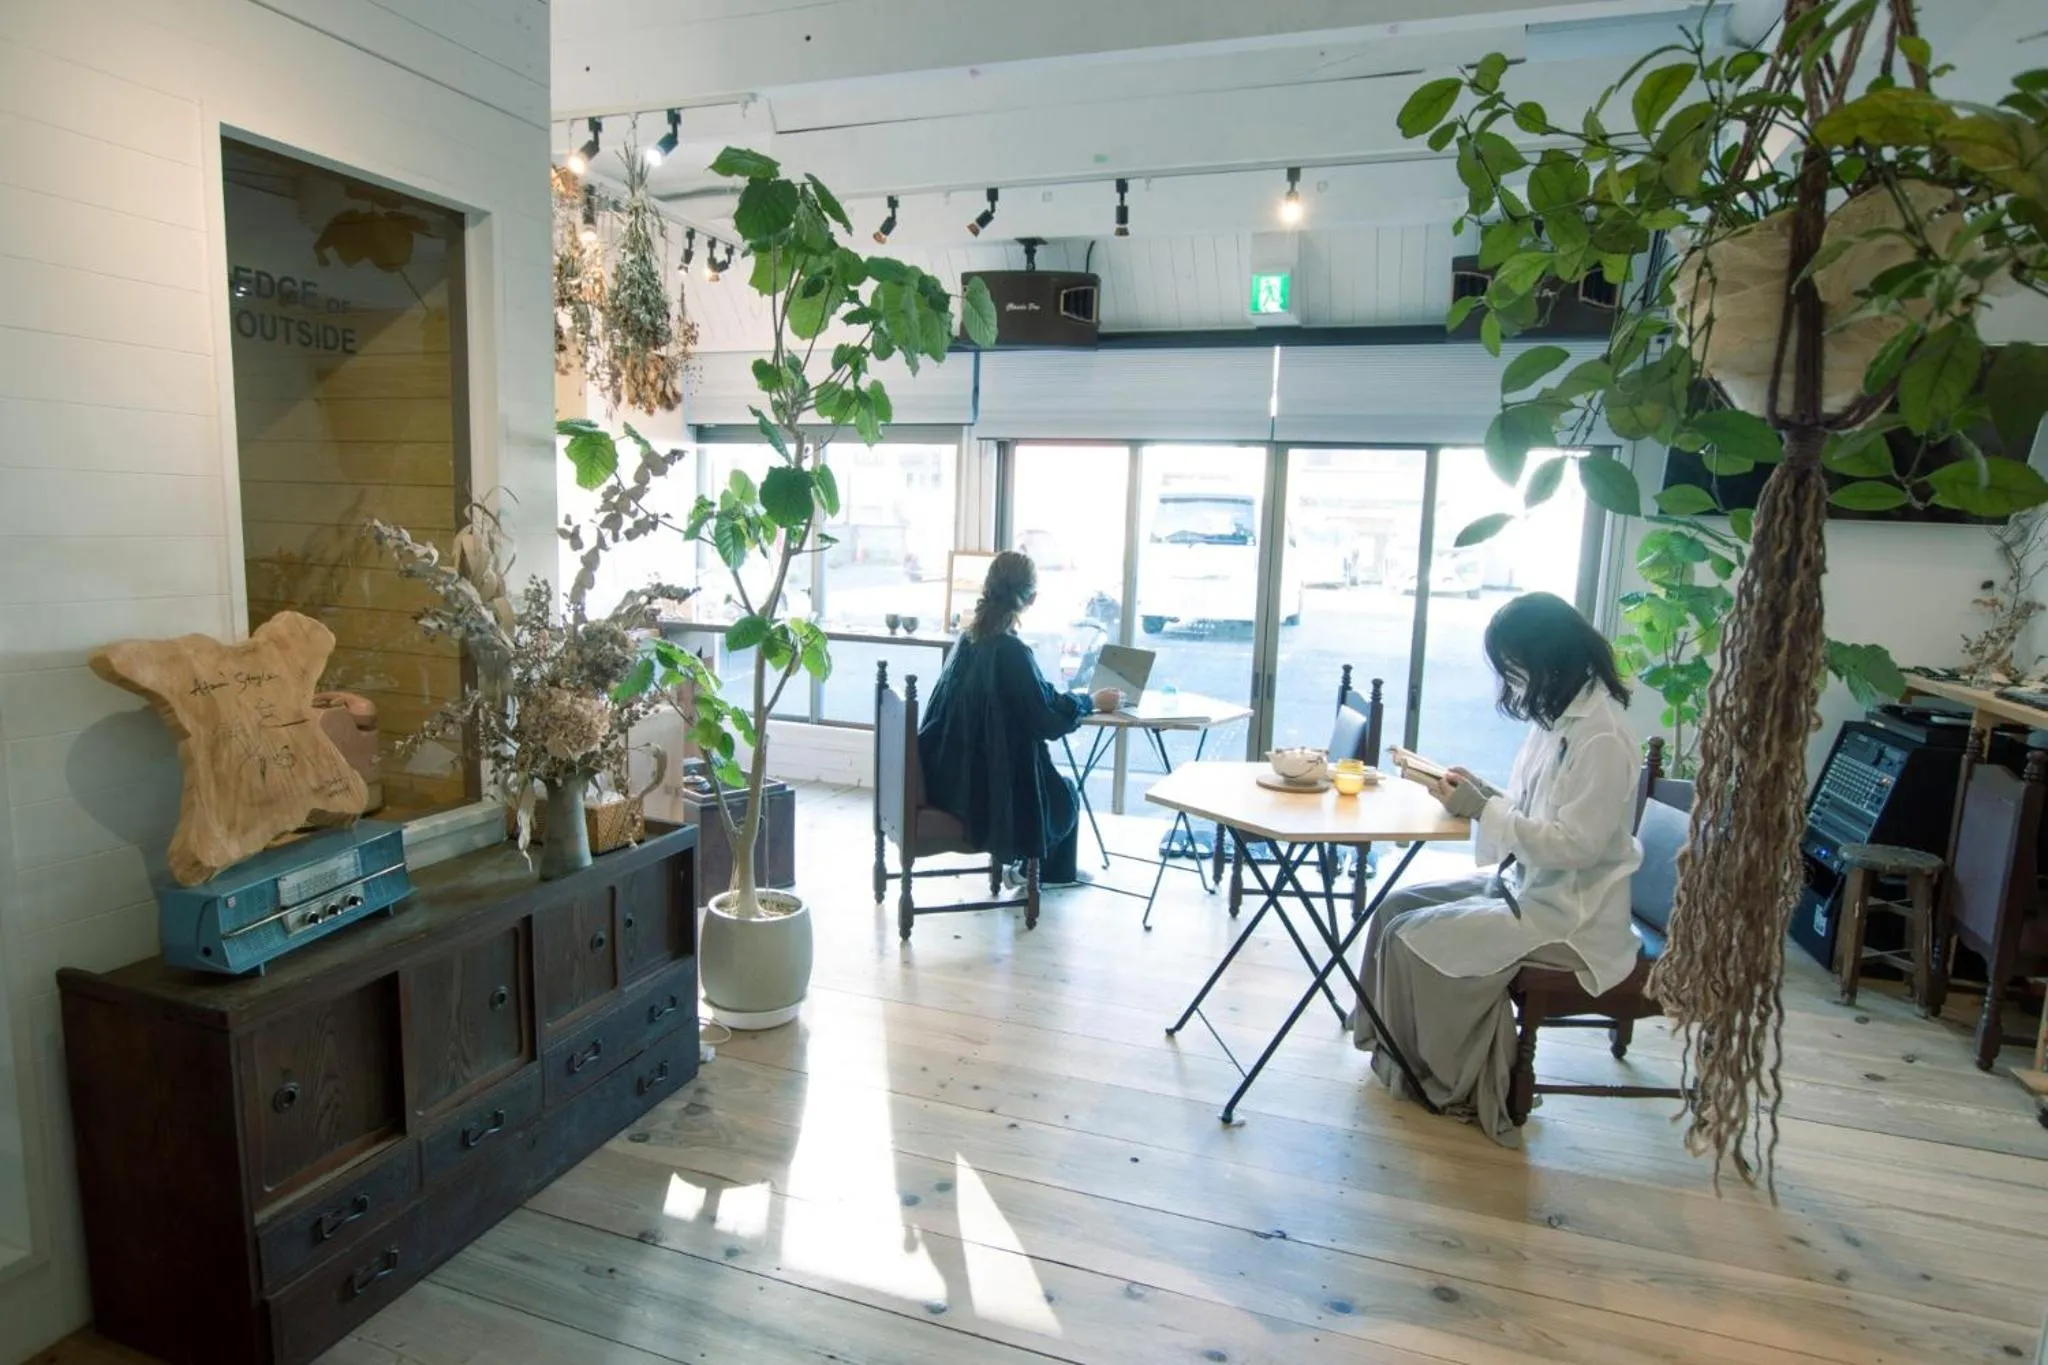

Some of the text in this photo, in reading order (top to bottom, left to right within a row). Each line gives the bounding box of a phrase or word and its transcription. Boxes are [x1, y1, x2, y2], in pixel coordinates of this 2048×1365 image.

[234, 265, 351, 314] EDGE OF
[235, 309, 357, 355] OUTSIDE
